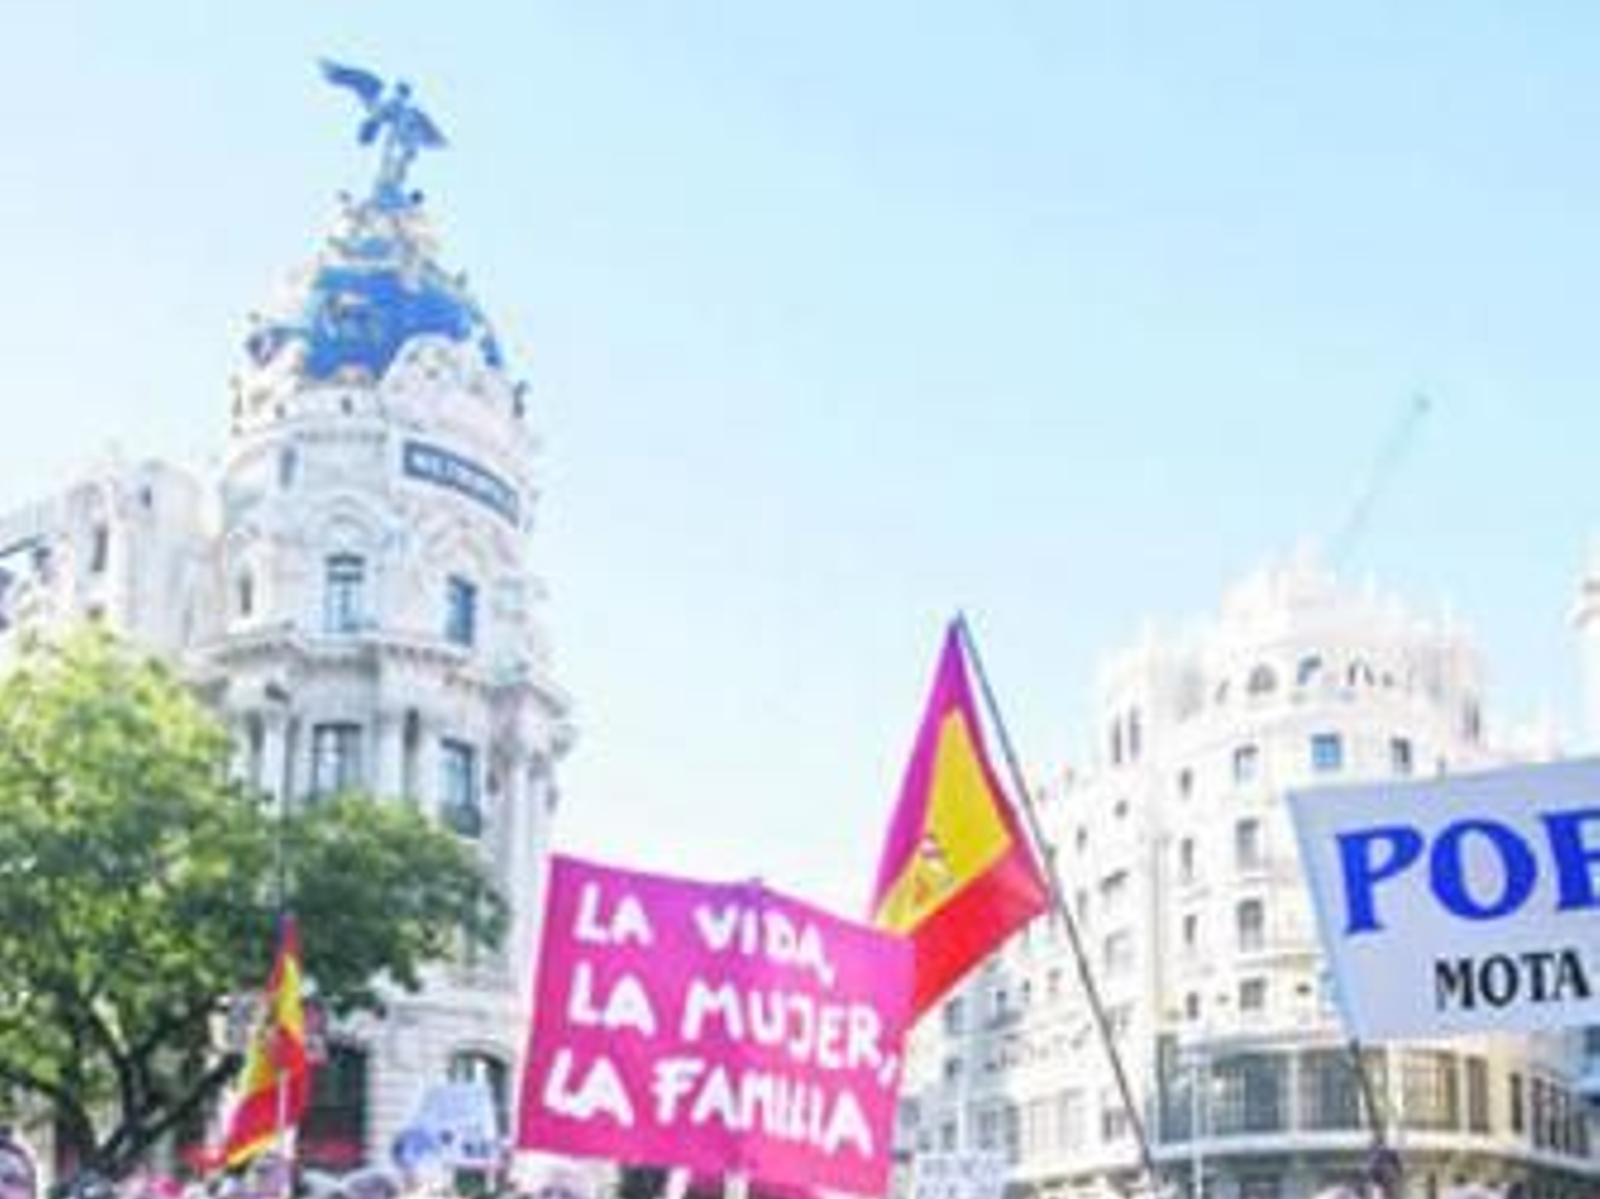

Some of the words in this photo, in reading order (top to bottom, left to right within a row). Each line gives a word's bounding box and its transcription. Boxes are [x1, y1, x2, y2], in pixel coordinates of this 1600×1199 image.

[573, 882, 653, 946] LA
[567, 961, 656, 1036] LA
[1435, 949, 1591, 1011] MOTA
[543, 1050, 634, 1126] LA
